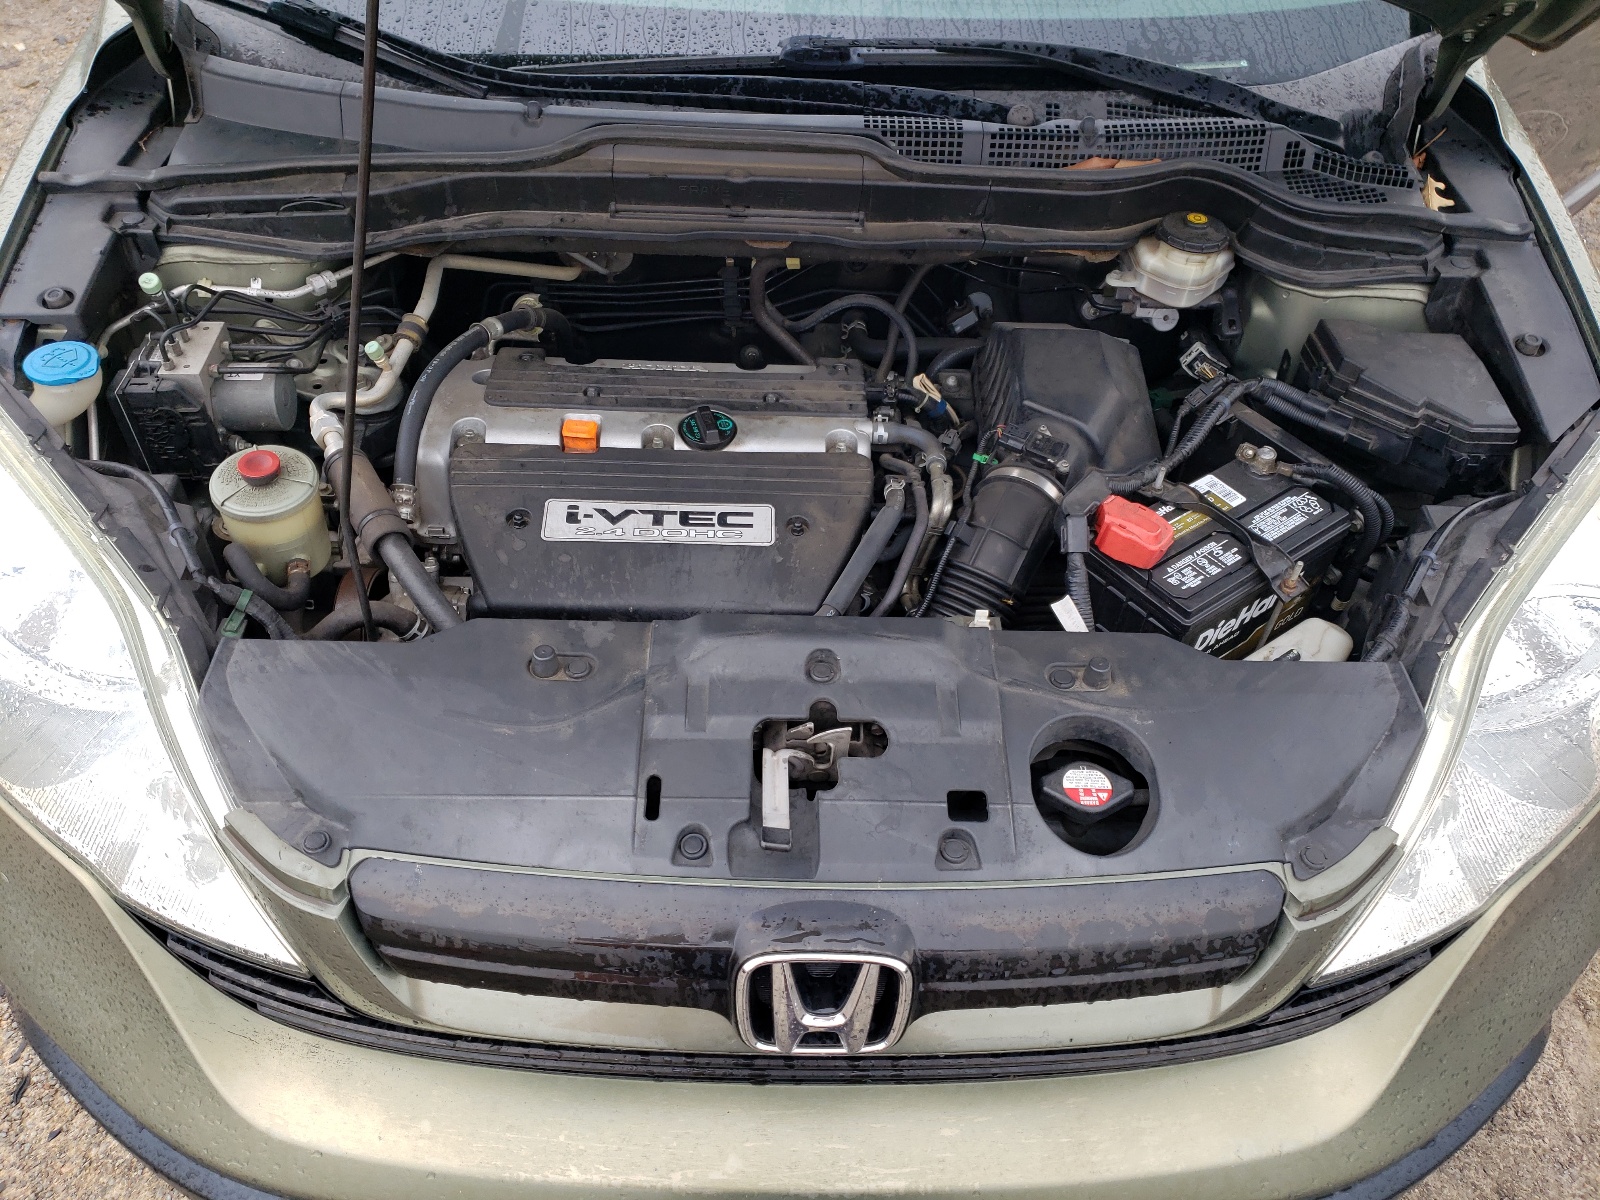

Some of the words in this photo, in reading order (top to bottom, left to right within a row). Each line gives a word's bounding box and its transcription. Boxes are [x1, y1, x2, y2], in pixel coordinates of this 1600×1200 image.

[565, 504, 754, 529] i-VTEC
[575, 526, 626, 538] 2.4
[632, 527, 744, 539] DOHC
[1273, 606, 1304, 631] GOLD
